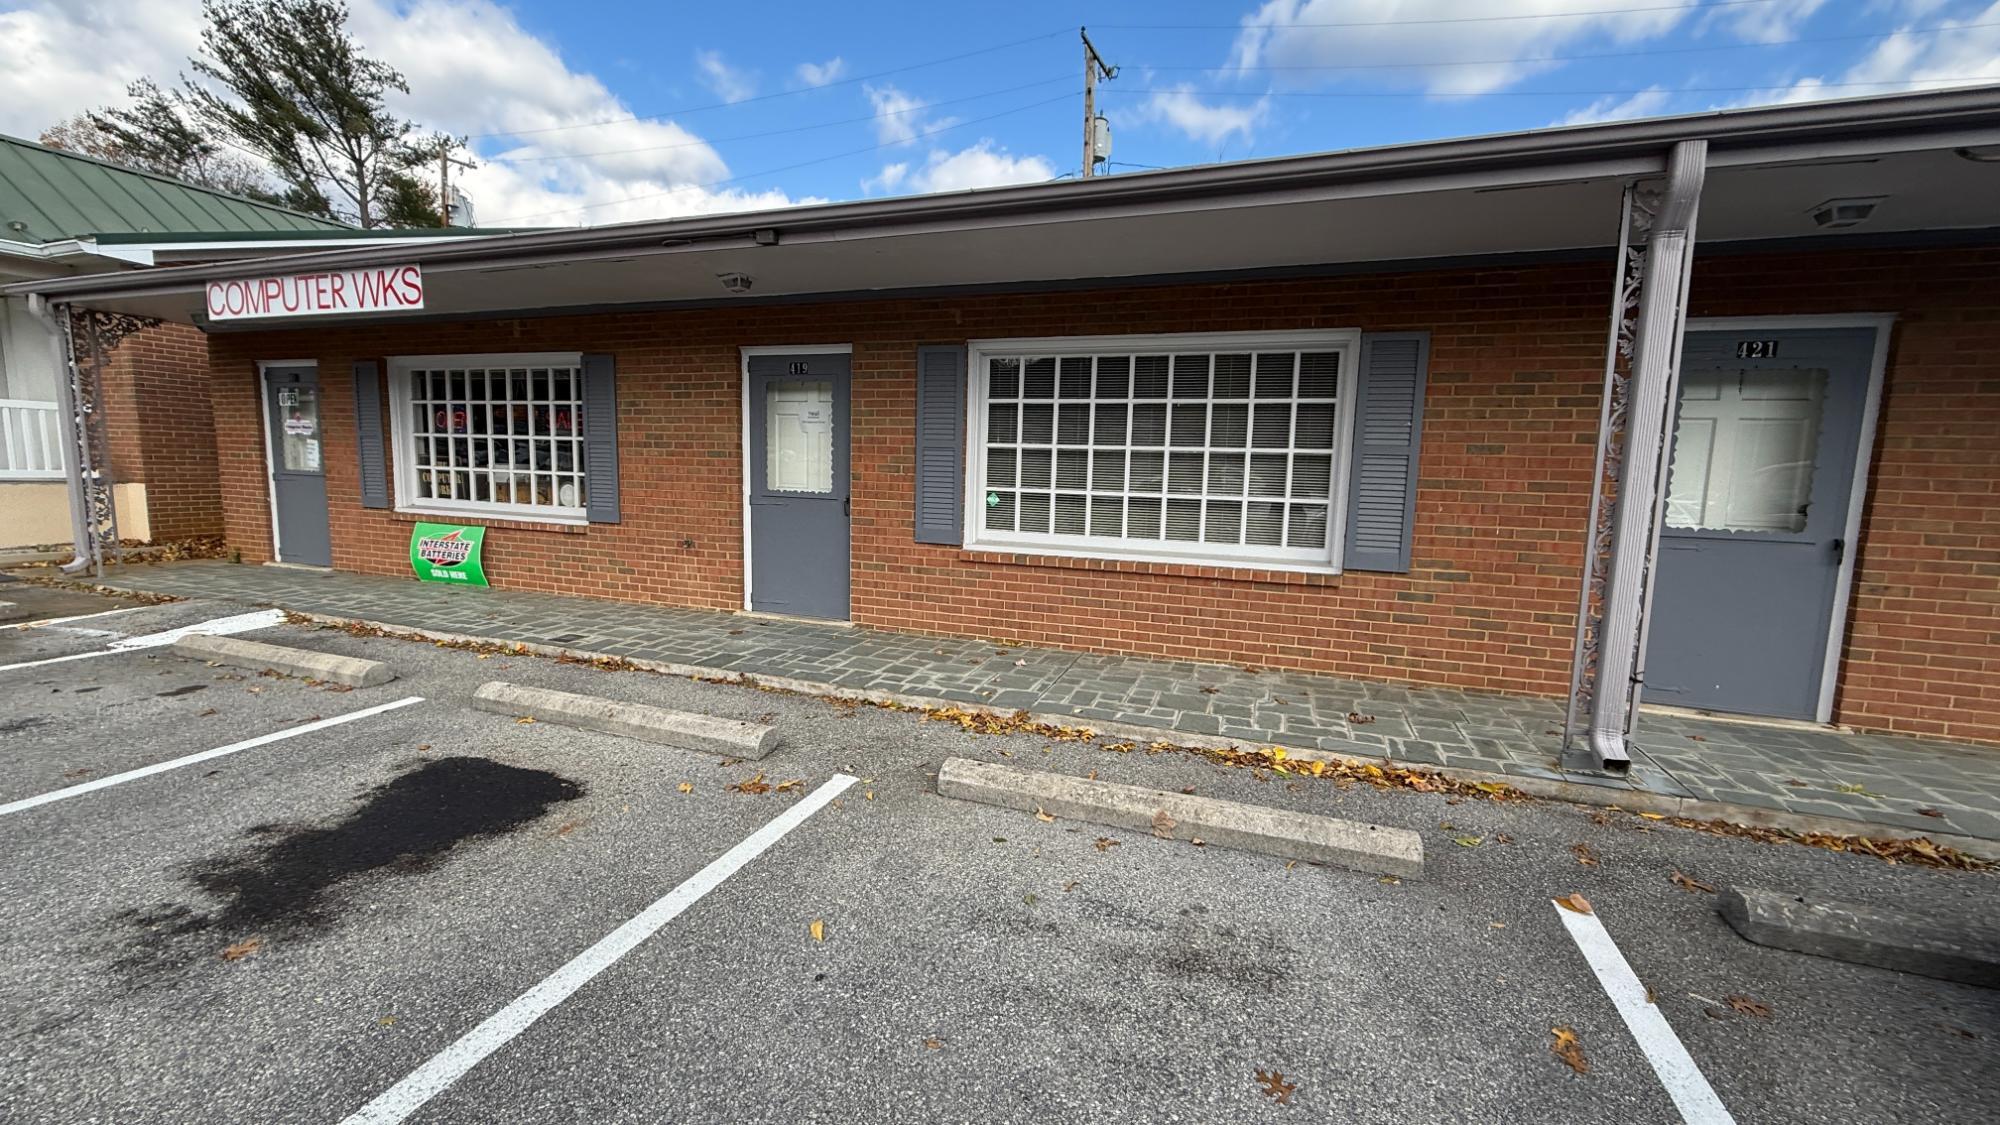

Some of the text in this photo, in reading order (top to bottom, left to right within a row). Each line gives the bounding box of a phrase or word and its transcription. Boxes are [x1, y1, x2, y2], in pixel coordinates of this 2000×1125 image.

[208, 267, 422, 316] COMPUTER WKS
[1737, 341, 1776, 358] 421
[789, 362, 809, 374] 419
[420, 540, 470, 551] INTERSTATE
[421, 550, 466, 560] BATTERIES
